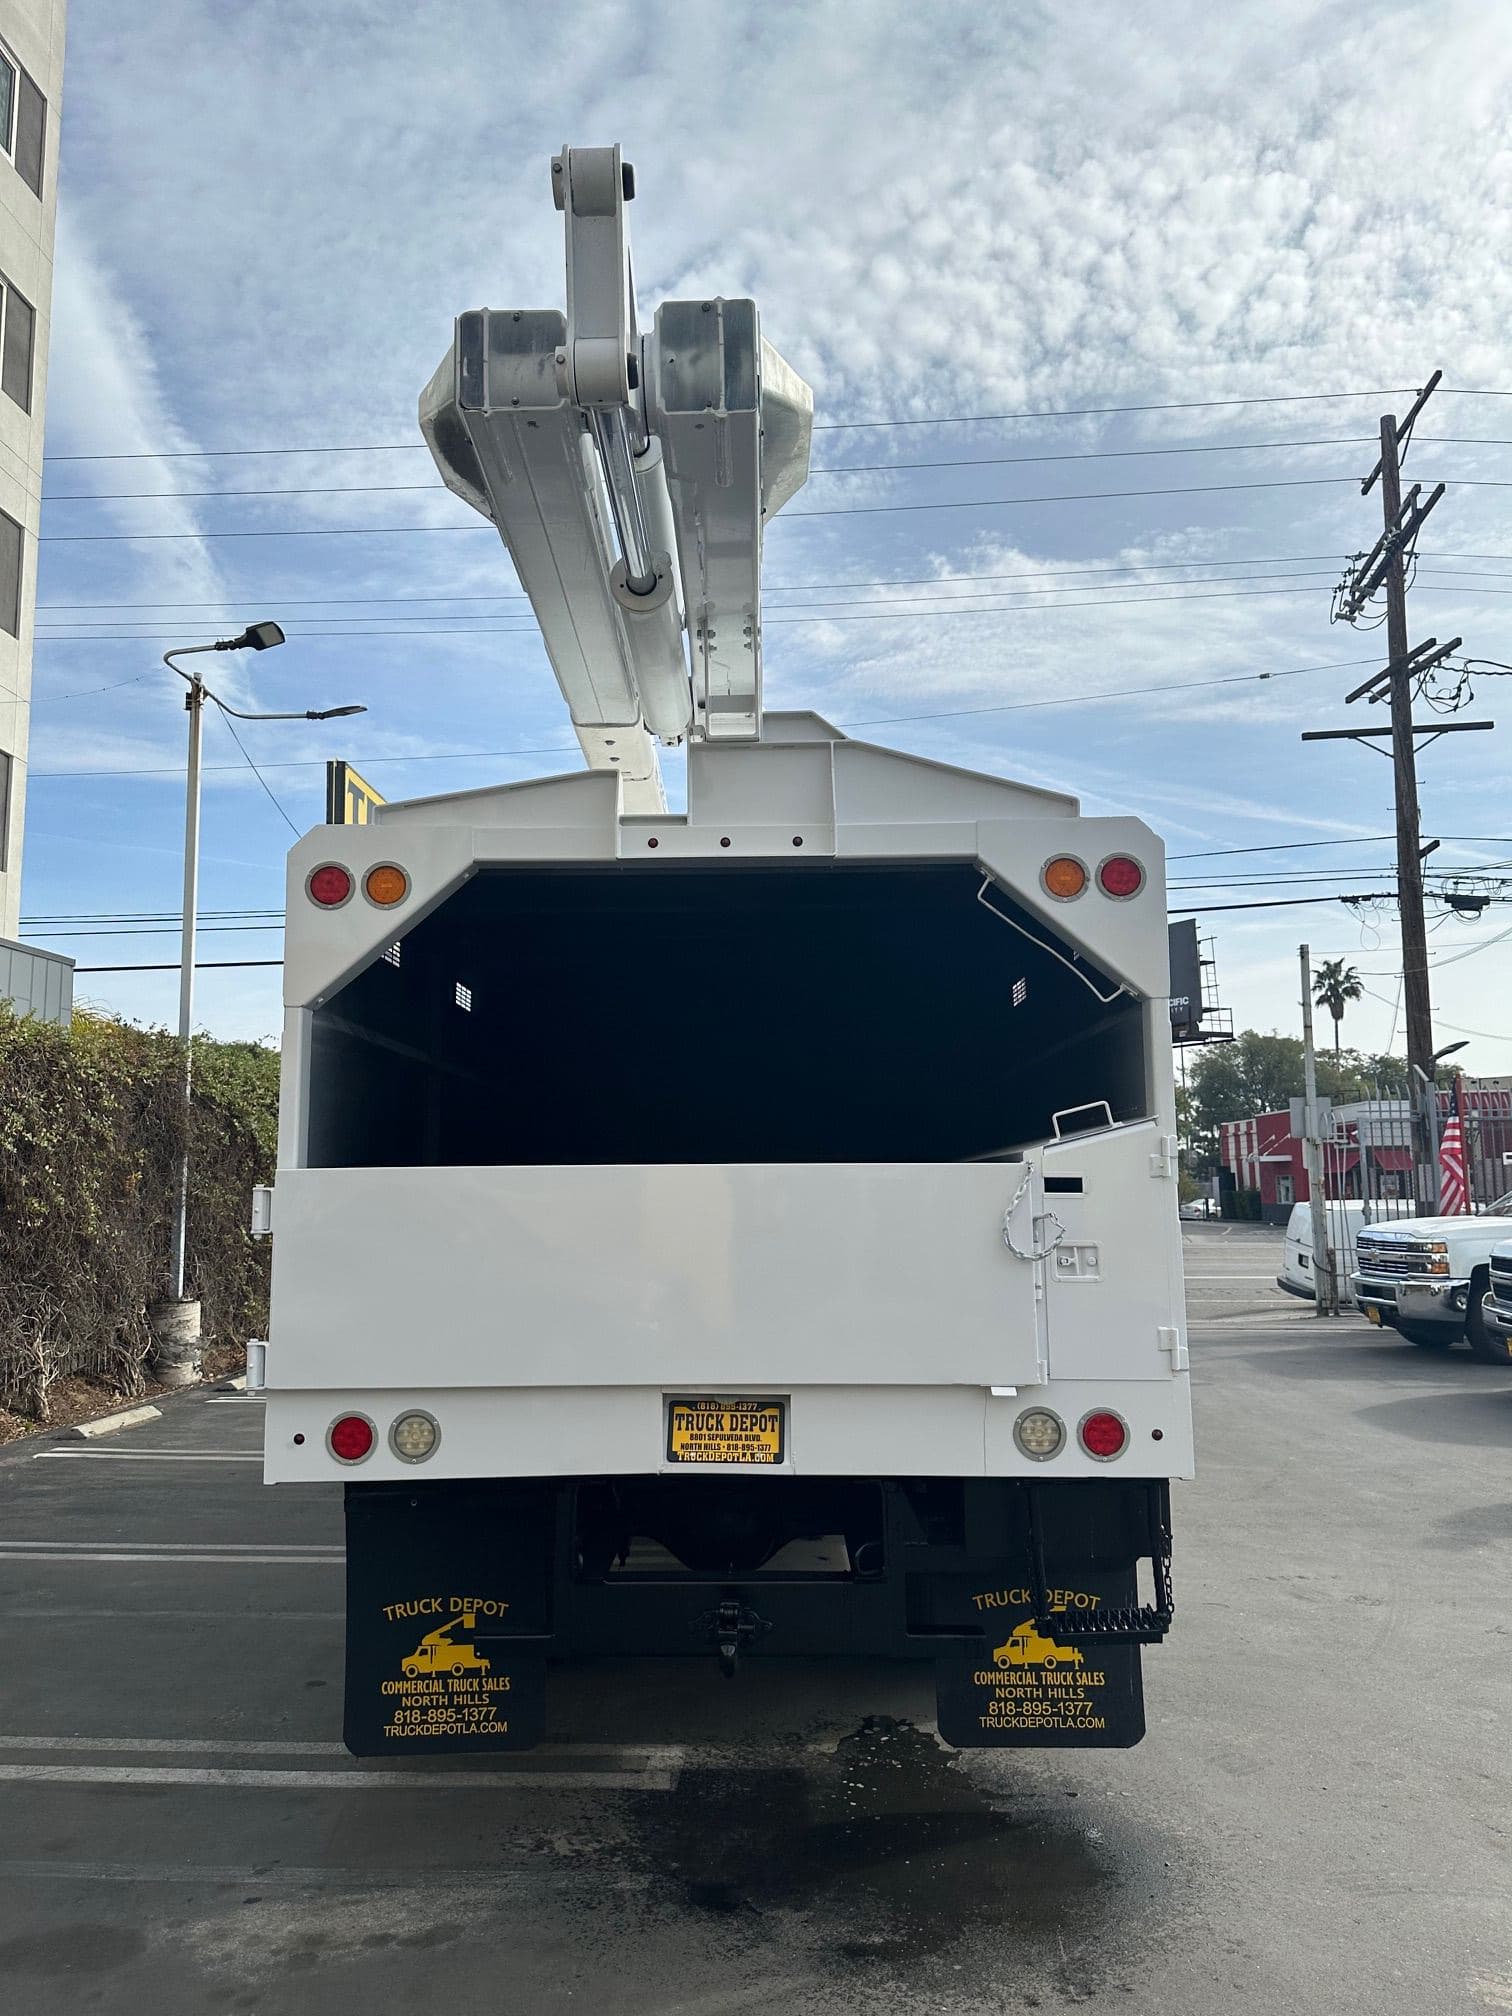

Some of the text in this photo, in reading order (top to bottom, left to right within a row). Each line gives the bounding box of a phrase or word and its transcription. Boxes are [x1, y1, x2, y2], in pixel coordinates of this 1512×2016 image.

[675, 1412, 779, 1433] TRUCK DEPOT
[689, 1433, 707, 1441] 8801
[707, 1433, 743, 1442] SEPULVEDA
[680, 1442, 772, 1452] NORTH HILLS 818-895-1377
[677, 1451, 775, 1463] TRUCKDEPOTLA.COM
[972, 1589, 1031, 1611] TRUCK
[383, 1597, 510, 1621] TRUCK DEPOT
[381, 1677, 511, 1695] COMMERCIAL TRUCK SALES
[974, 1671, 1106, 1686] COMMERCIAL TRUCK SALES
[401, 1693, 490, 1707] NORTH HILLS
[995, 1687, 1085, 1699] NORTH HILLS
[393, 1706, 498, 1724] 818-895-1377
[988, 1701, 1093, 1716] 818-895-1377
[383, 1721, 508, 1737] TRUCKDEPOTLA.COM
[979, 1716, 1105, 1729] TRUCKDEPOTLA.COM
